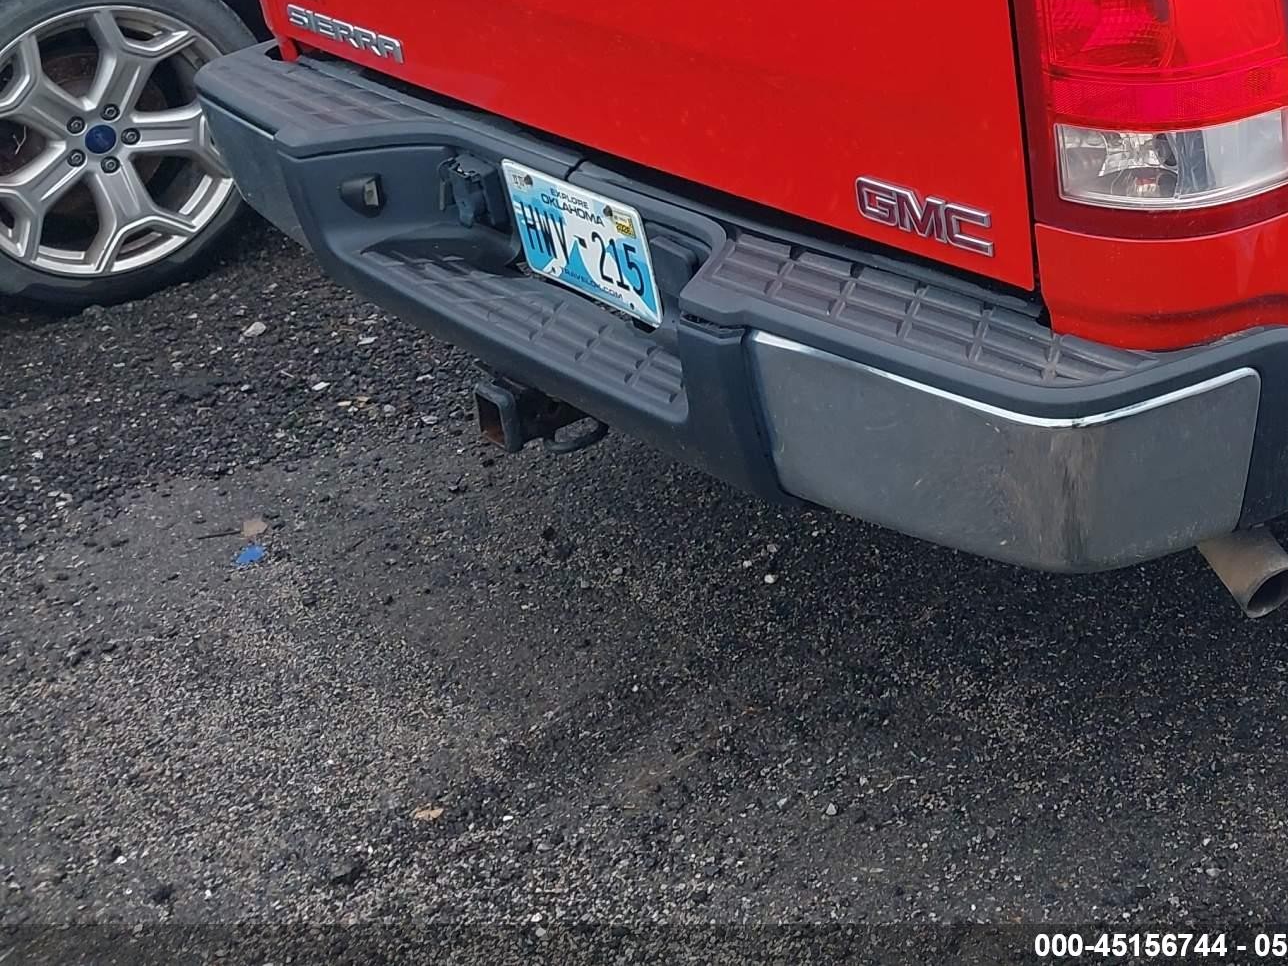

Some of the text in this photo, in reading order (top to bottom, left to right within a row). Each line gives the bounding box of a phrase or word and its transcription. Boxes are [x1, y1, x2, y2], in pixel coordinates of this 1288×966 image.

[287, 4, 405, 64] SIERRA
[540, 193, 605, 228] OKLAHOMA
[550, 187, 589, 210] EXPLORE
[855, 176, 995, 258] GMC
[560, 266, 623, 299] TRAVELOK.COM
